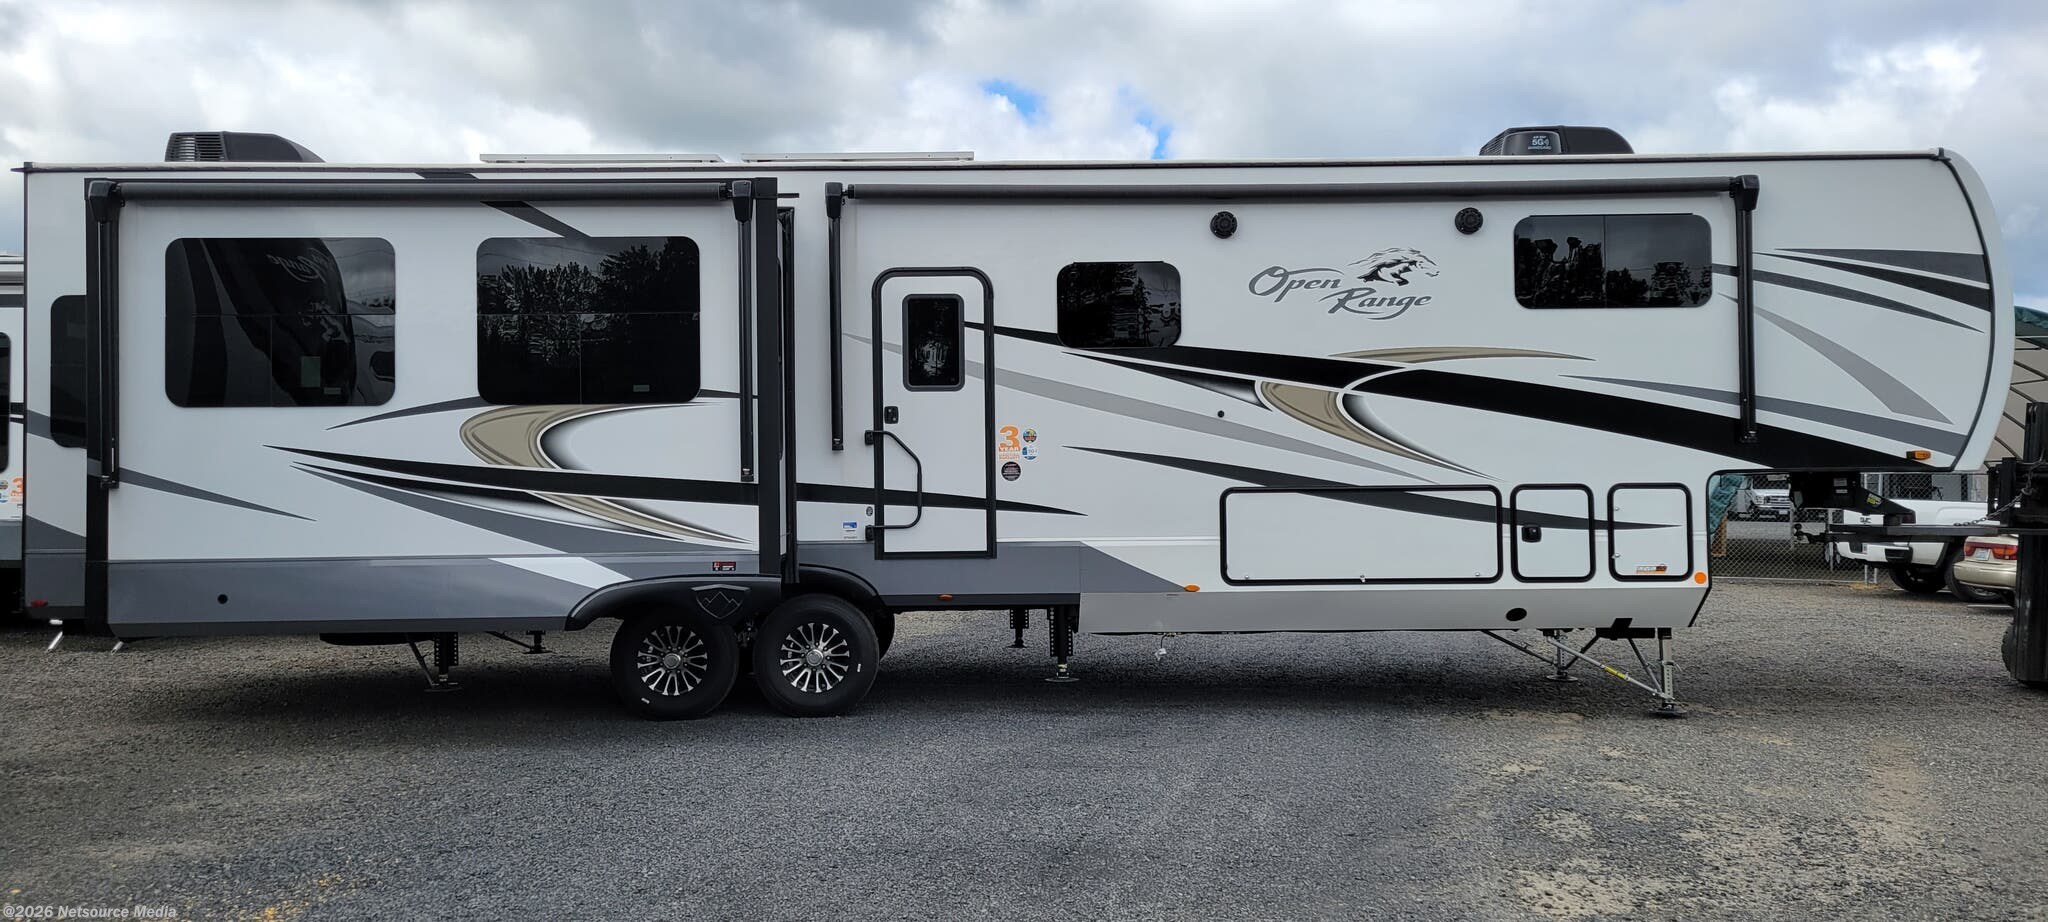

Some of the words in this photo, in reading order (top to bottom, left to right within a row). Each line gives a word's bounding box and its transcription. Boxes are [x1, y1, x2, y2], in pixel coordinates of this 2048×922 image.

[1249, 266, 1344, 302] Open
[1319, 287, 1431, 320] Range
[999, 426, 1019, 449] 3
